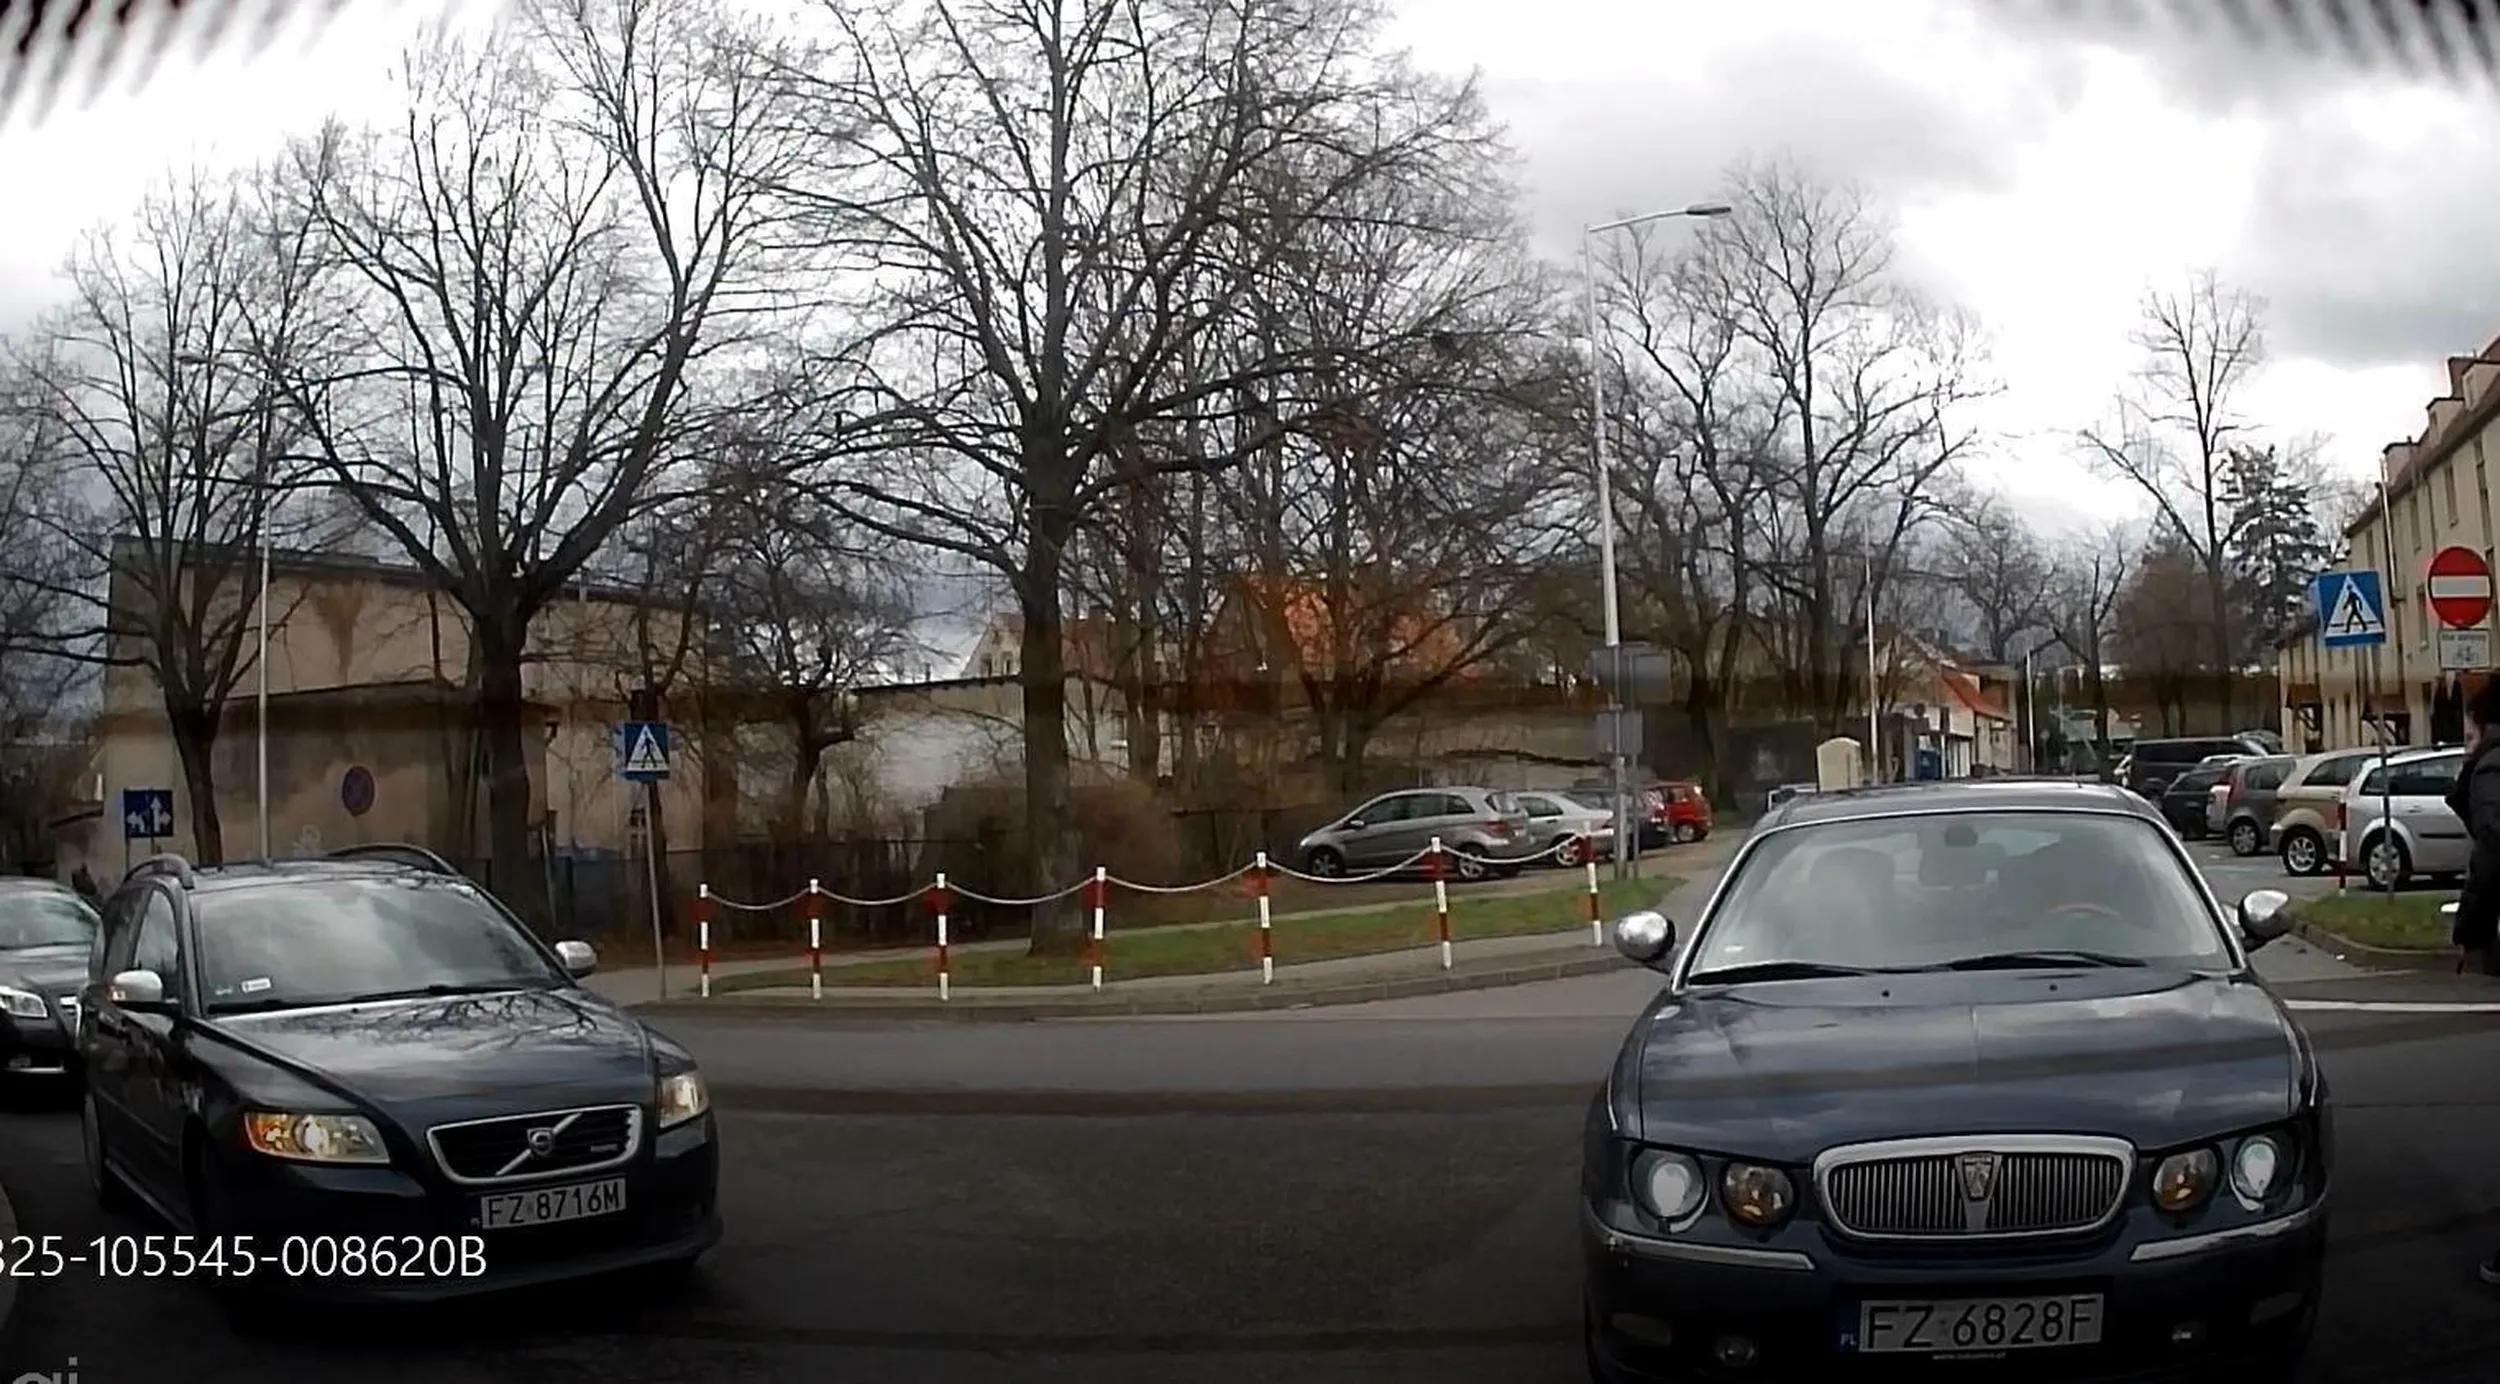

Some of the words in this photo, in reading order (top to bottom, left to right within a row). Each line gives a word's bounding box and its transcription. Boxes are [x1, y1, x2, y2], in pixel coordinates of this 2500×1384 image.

[487, 1195, 524, 1226] FZ
[536, 1182, 620, 1220] 8716M
[1867, 1305, 1934, 1349] FZ
[1952, 1298, 2097, 1346] 6828F
